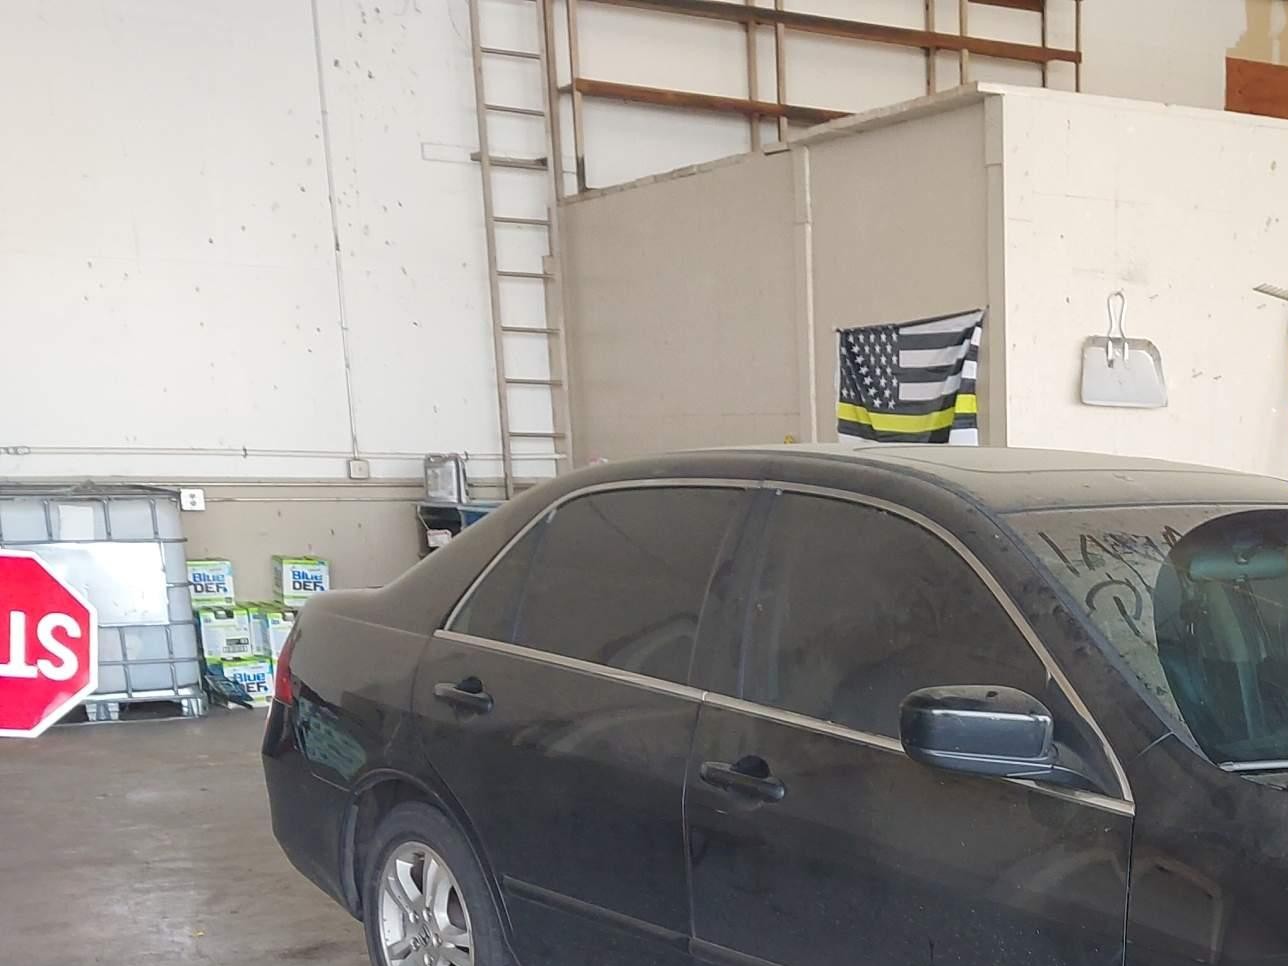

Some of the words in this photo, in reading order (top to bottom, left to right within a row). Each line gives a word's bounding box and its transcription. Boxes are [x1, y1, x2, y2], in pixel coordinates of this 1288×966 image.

[192, 572, 225, 582] Blue
[292, 570, 323, 581] Blue
[194, 583, 228, 593] DEF
[292, 581, 325, 592] DEF
